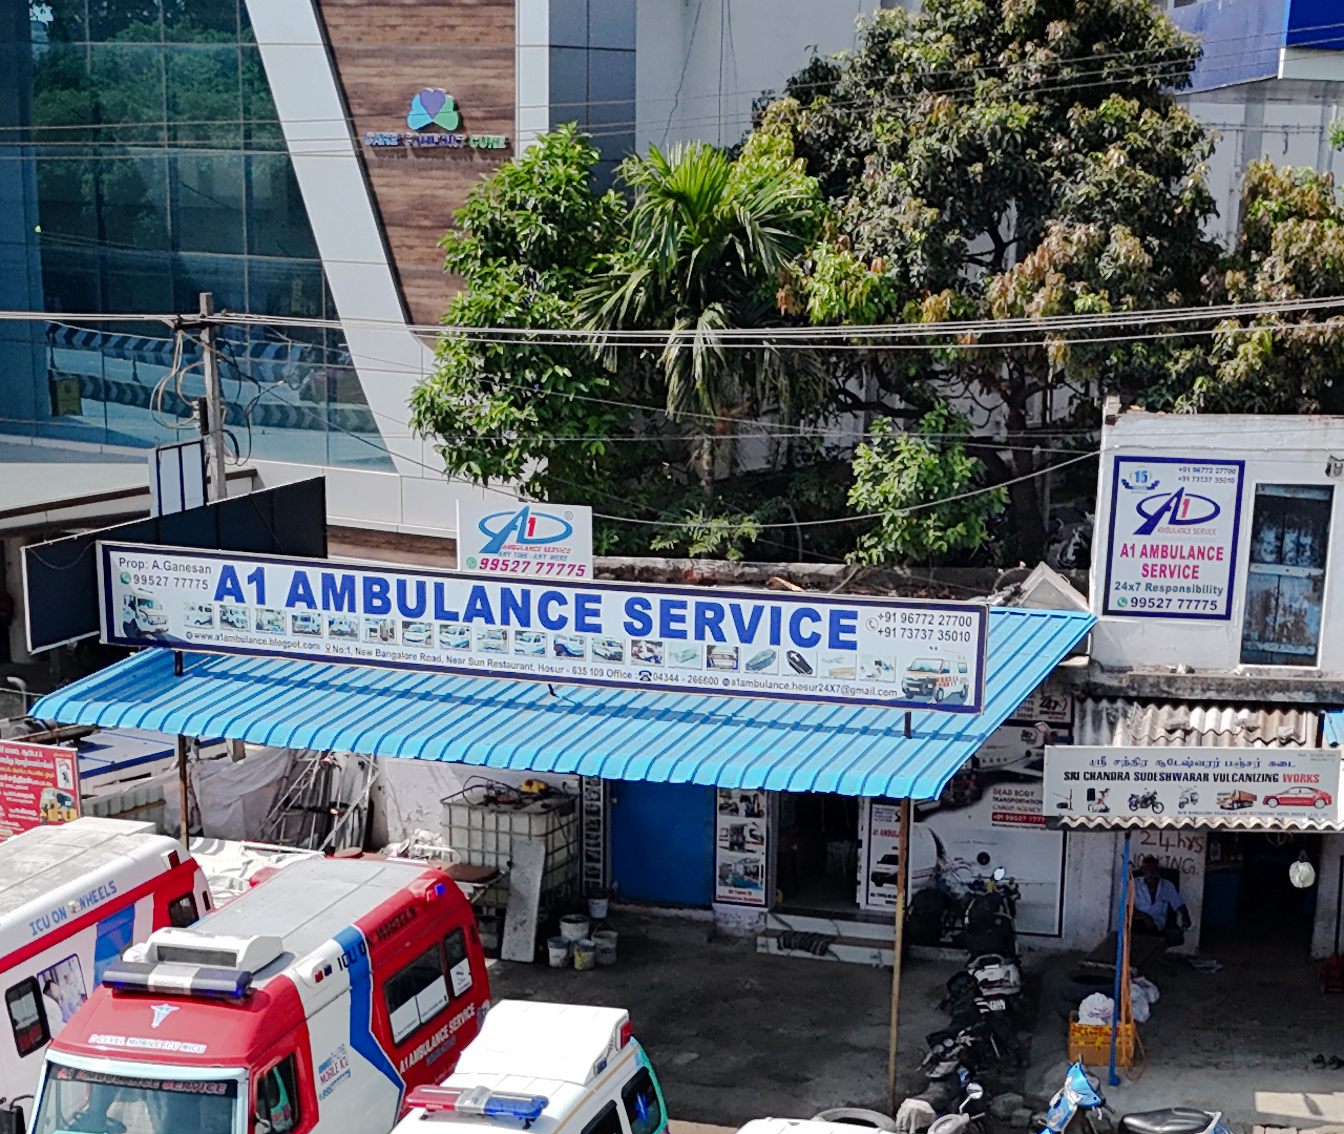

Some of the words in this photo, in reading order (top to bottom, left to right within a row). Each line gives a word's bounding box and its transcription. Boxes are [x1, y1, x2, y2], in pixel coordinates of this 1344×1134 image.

[1120, 543, 1136, 559] A1
[1140, 544, 1224, 561] AMBULANCE
[119, 557, 149, 570] Prop:
[152, 559, 213, 575] A.Ganesan
[479, 558, 531, 573] 99527
[536, 562, 587, 577] 77775
[1142, 563, 1200, 580] SERVICE
[133, 574, 169, 587] 99527
[174, 576, 209, 590] 77775
[1115, 581, 1142, 592] 24x7
[1145, 582, 1224, 597] Responsibility
[214, 564, 267, 606] A1
[285, 569, 604, 635] AMBULANCE
[623, 596, 859, 651] SERVICE
[1130, 597, 1173, 610] 99527
[1177, 598, 1218, 611] 77775
[877, 611, 897, 623] +91
[900, 612, 935, 626] 96772
[938, 614, 973, 628] 27700
[877, 627, 897, 638] +91
[900, 628, 934, 640] 73737
[937, 630, 971, 643] 35010
[356, 647, 373, 656] New
[446, 654, 466, 666] Near
[469, 657, 485, 668] Sun
[538, 663, 565, 674] Hosur
[572, 666, 588, 676] 635
[1063, 771, 1080, 781] SRI
[1083, 771, 1130, 781] CHANDRA
[1213, 772, 1279, 783] VULCANIZING
[1283, 773, 1320, 783] WORKS
[1140, 830, 1176, 852] 24
[29, 913, 51, 937] ICU
[51, 908, 68, 928] ON
[78, 880, 118, 912] WHEELS
[449, 1002, 476, 1034] SERVICE
[76, 1070, 160, 1089] AMBULANCE
[162, 1080, 227, 1095] SERVICE
